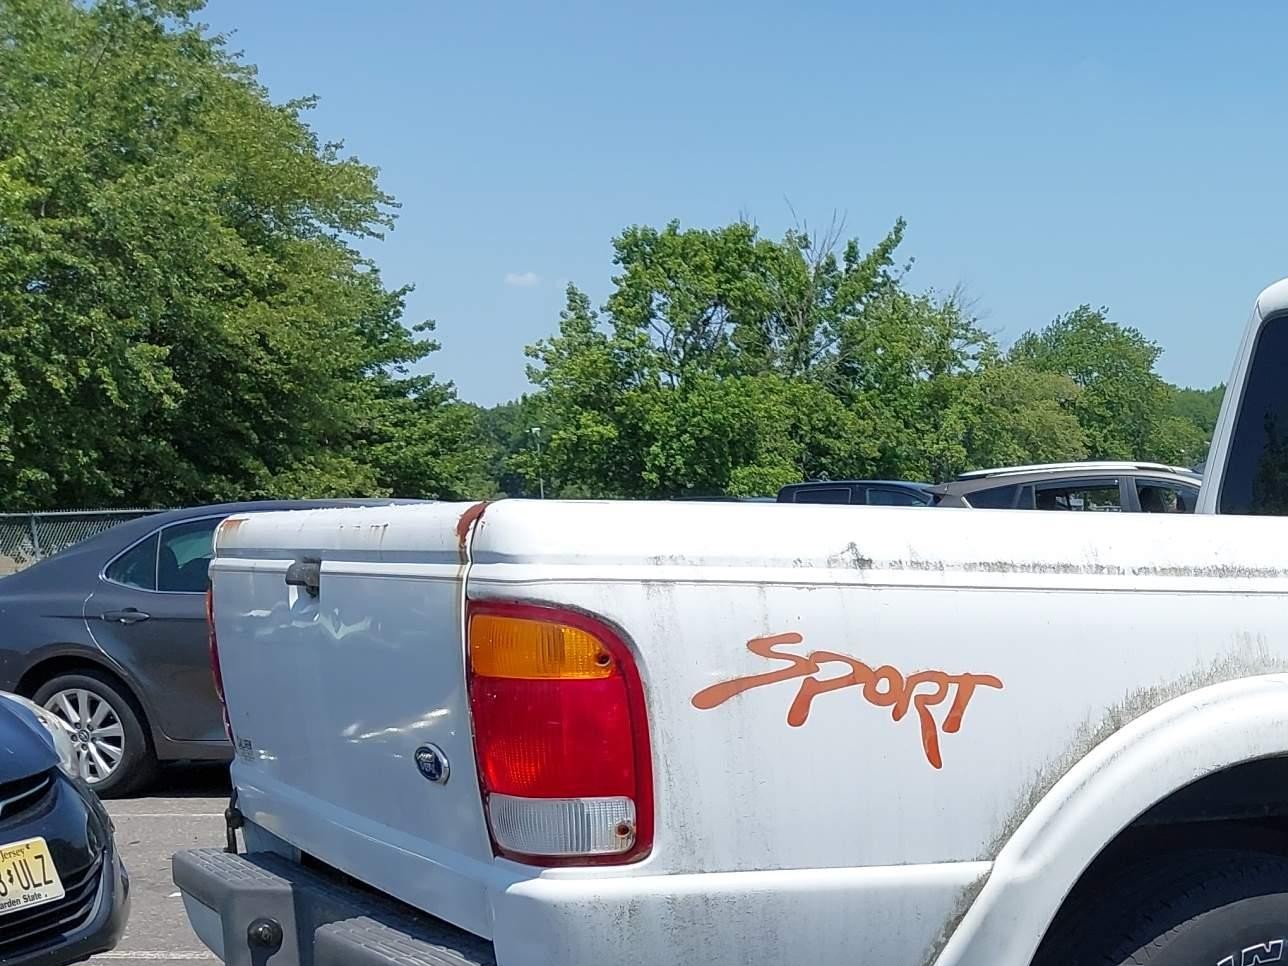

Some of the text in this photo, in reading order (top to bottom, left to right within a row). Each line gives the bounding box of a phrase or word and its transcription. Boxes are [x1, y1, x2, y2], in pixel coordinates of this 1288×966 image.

[691, 632, 1003, 769] SPORT
[0, 848, 25, 863] Jersey
[0, 892, 42, 910] arden State
